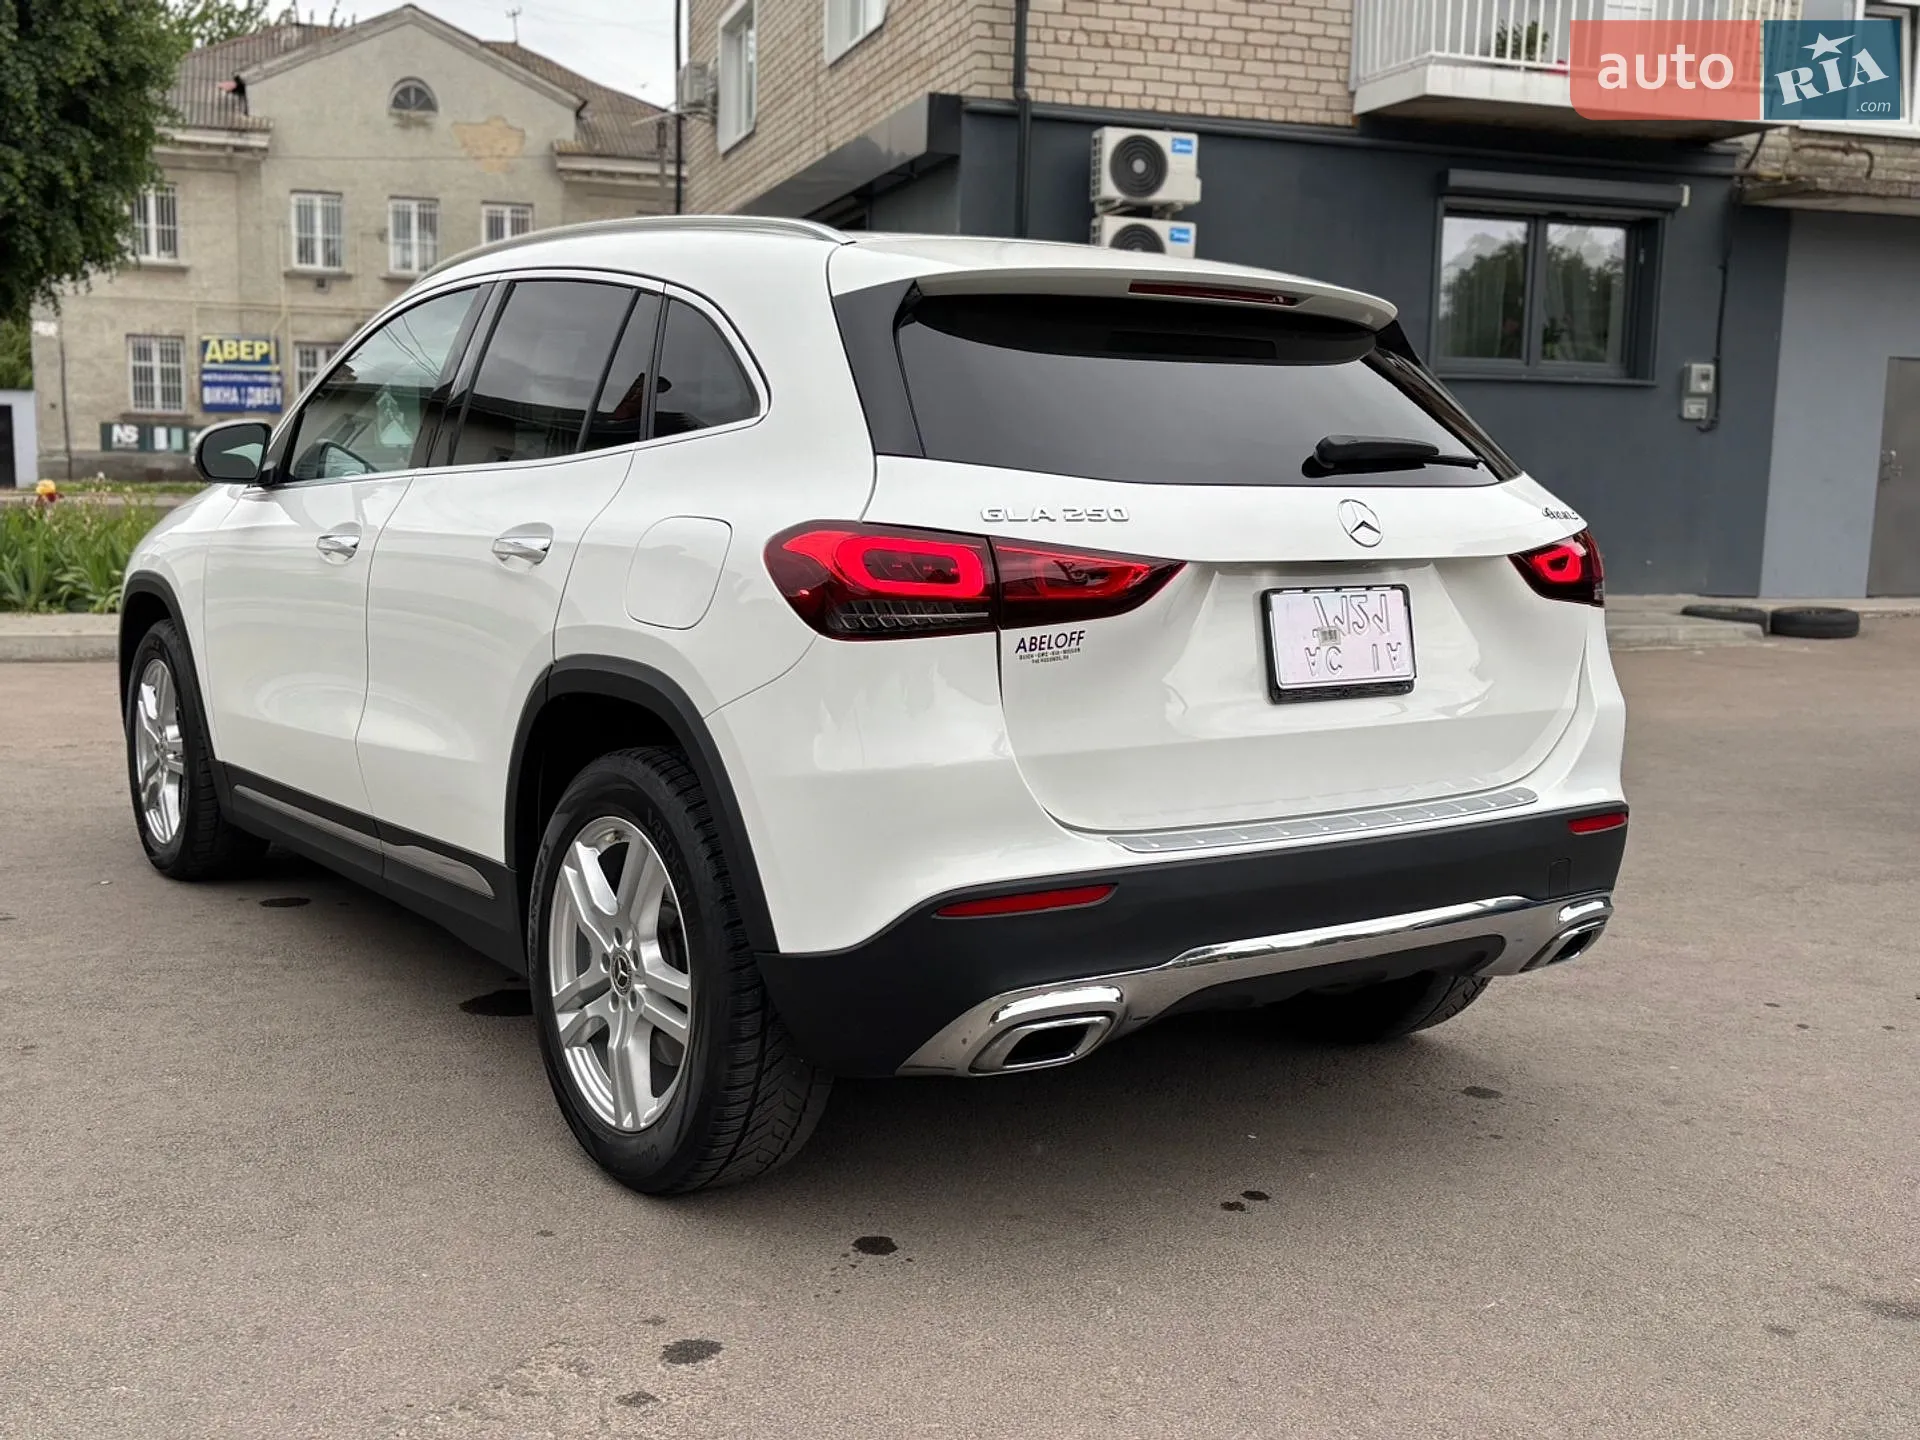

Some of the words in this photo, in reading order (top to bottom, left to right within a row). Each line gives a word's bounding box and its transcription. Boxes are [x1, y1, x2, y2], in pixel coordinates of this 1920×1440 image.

[980, 505, 1057, 523] GLA
[1062, 505, 1130, 523] 250
[1015, 630, 1086, 654] ABELOFF
